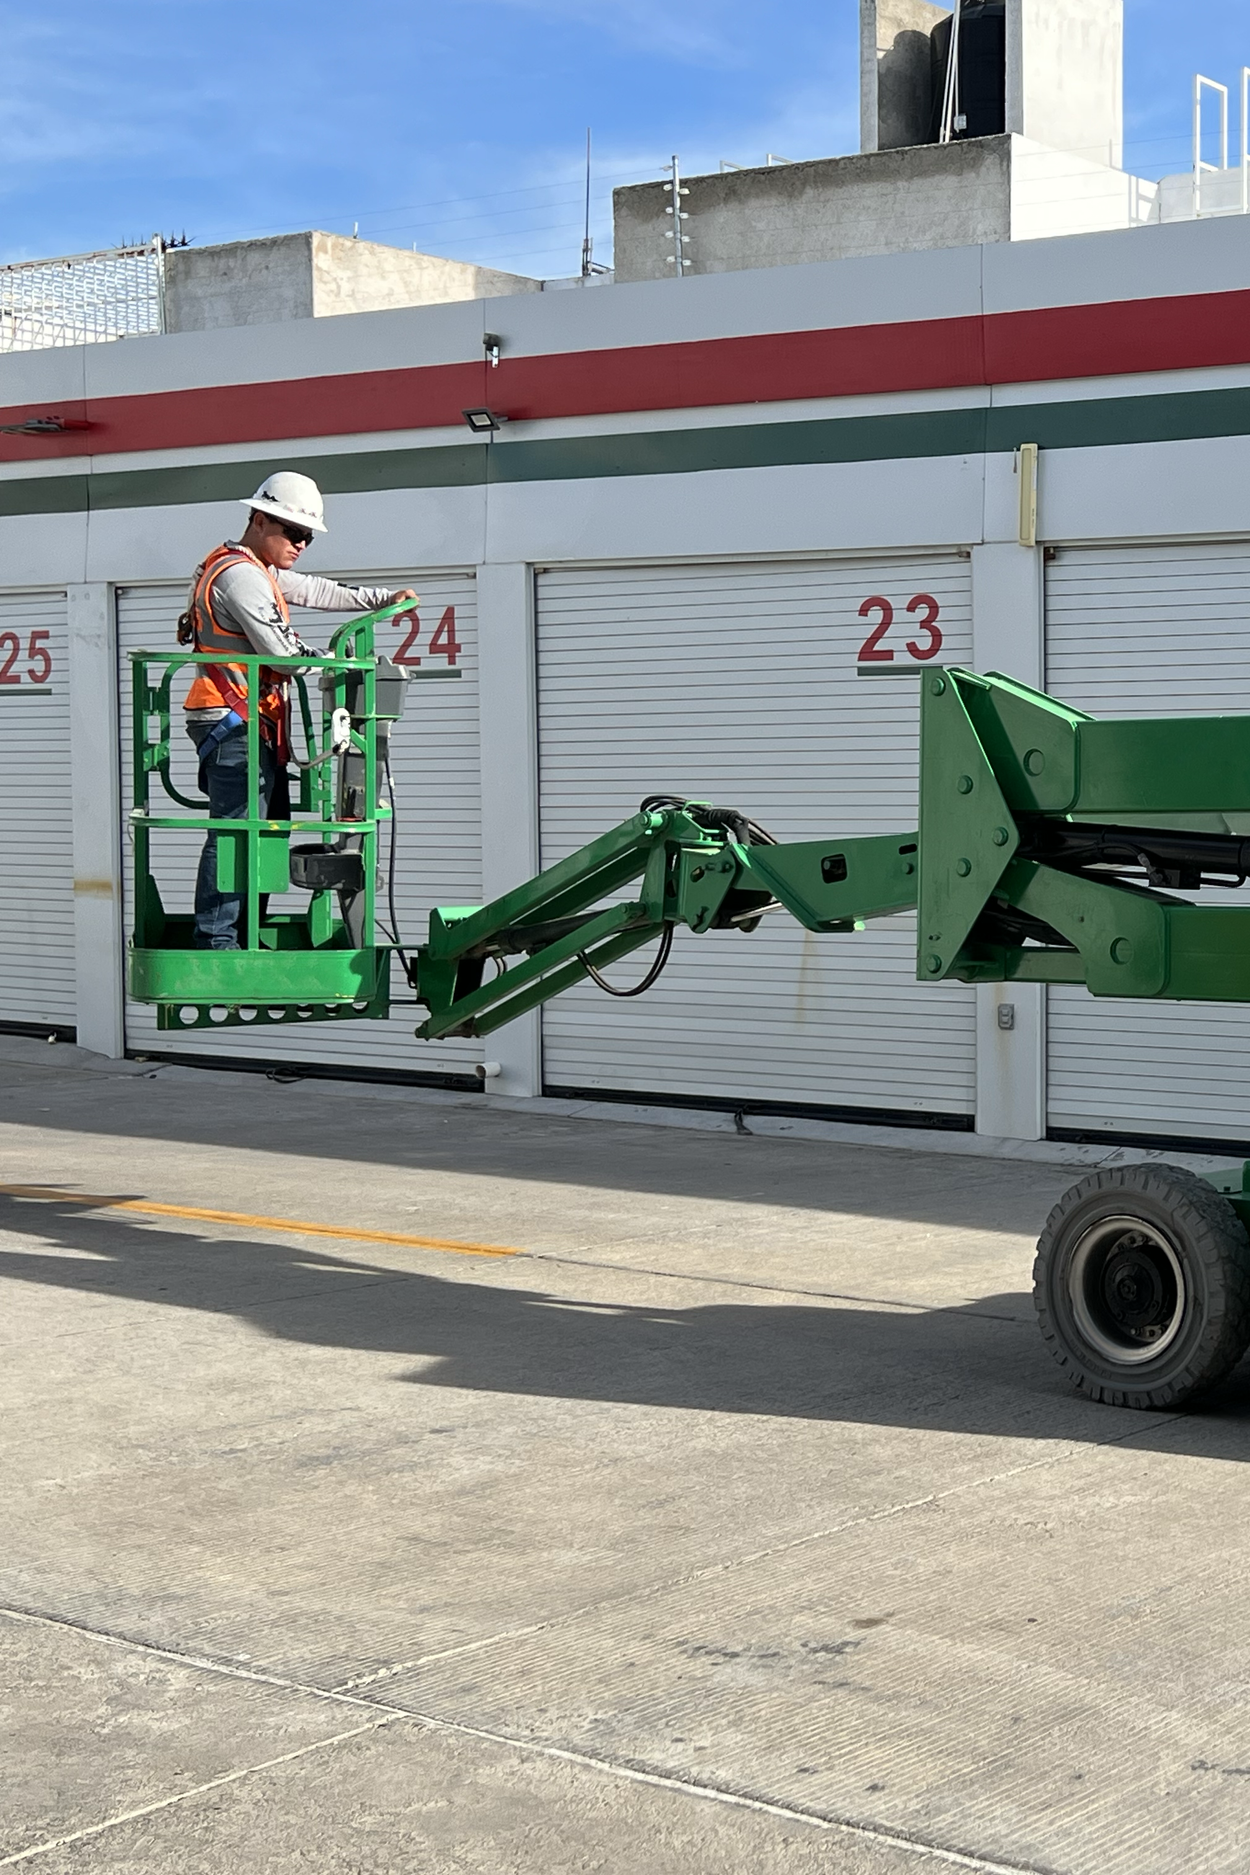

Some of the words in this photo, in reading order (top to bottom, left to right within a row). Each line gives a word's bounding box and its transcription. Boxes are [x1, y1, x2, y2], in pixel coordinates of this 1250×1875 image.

[0, 630, 52, 684] 25
[391, 605, 462, 666] 24
[857, 593, 943, 661] 23
